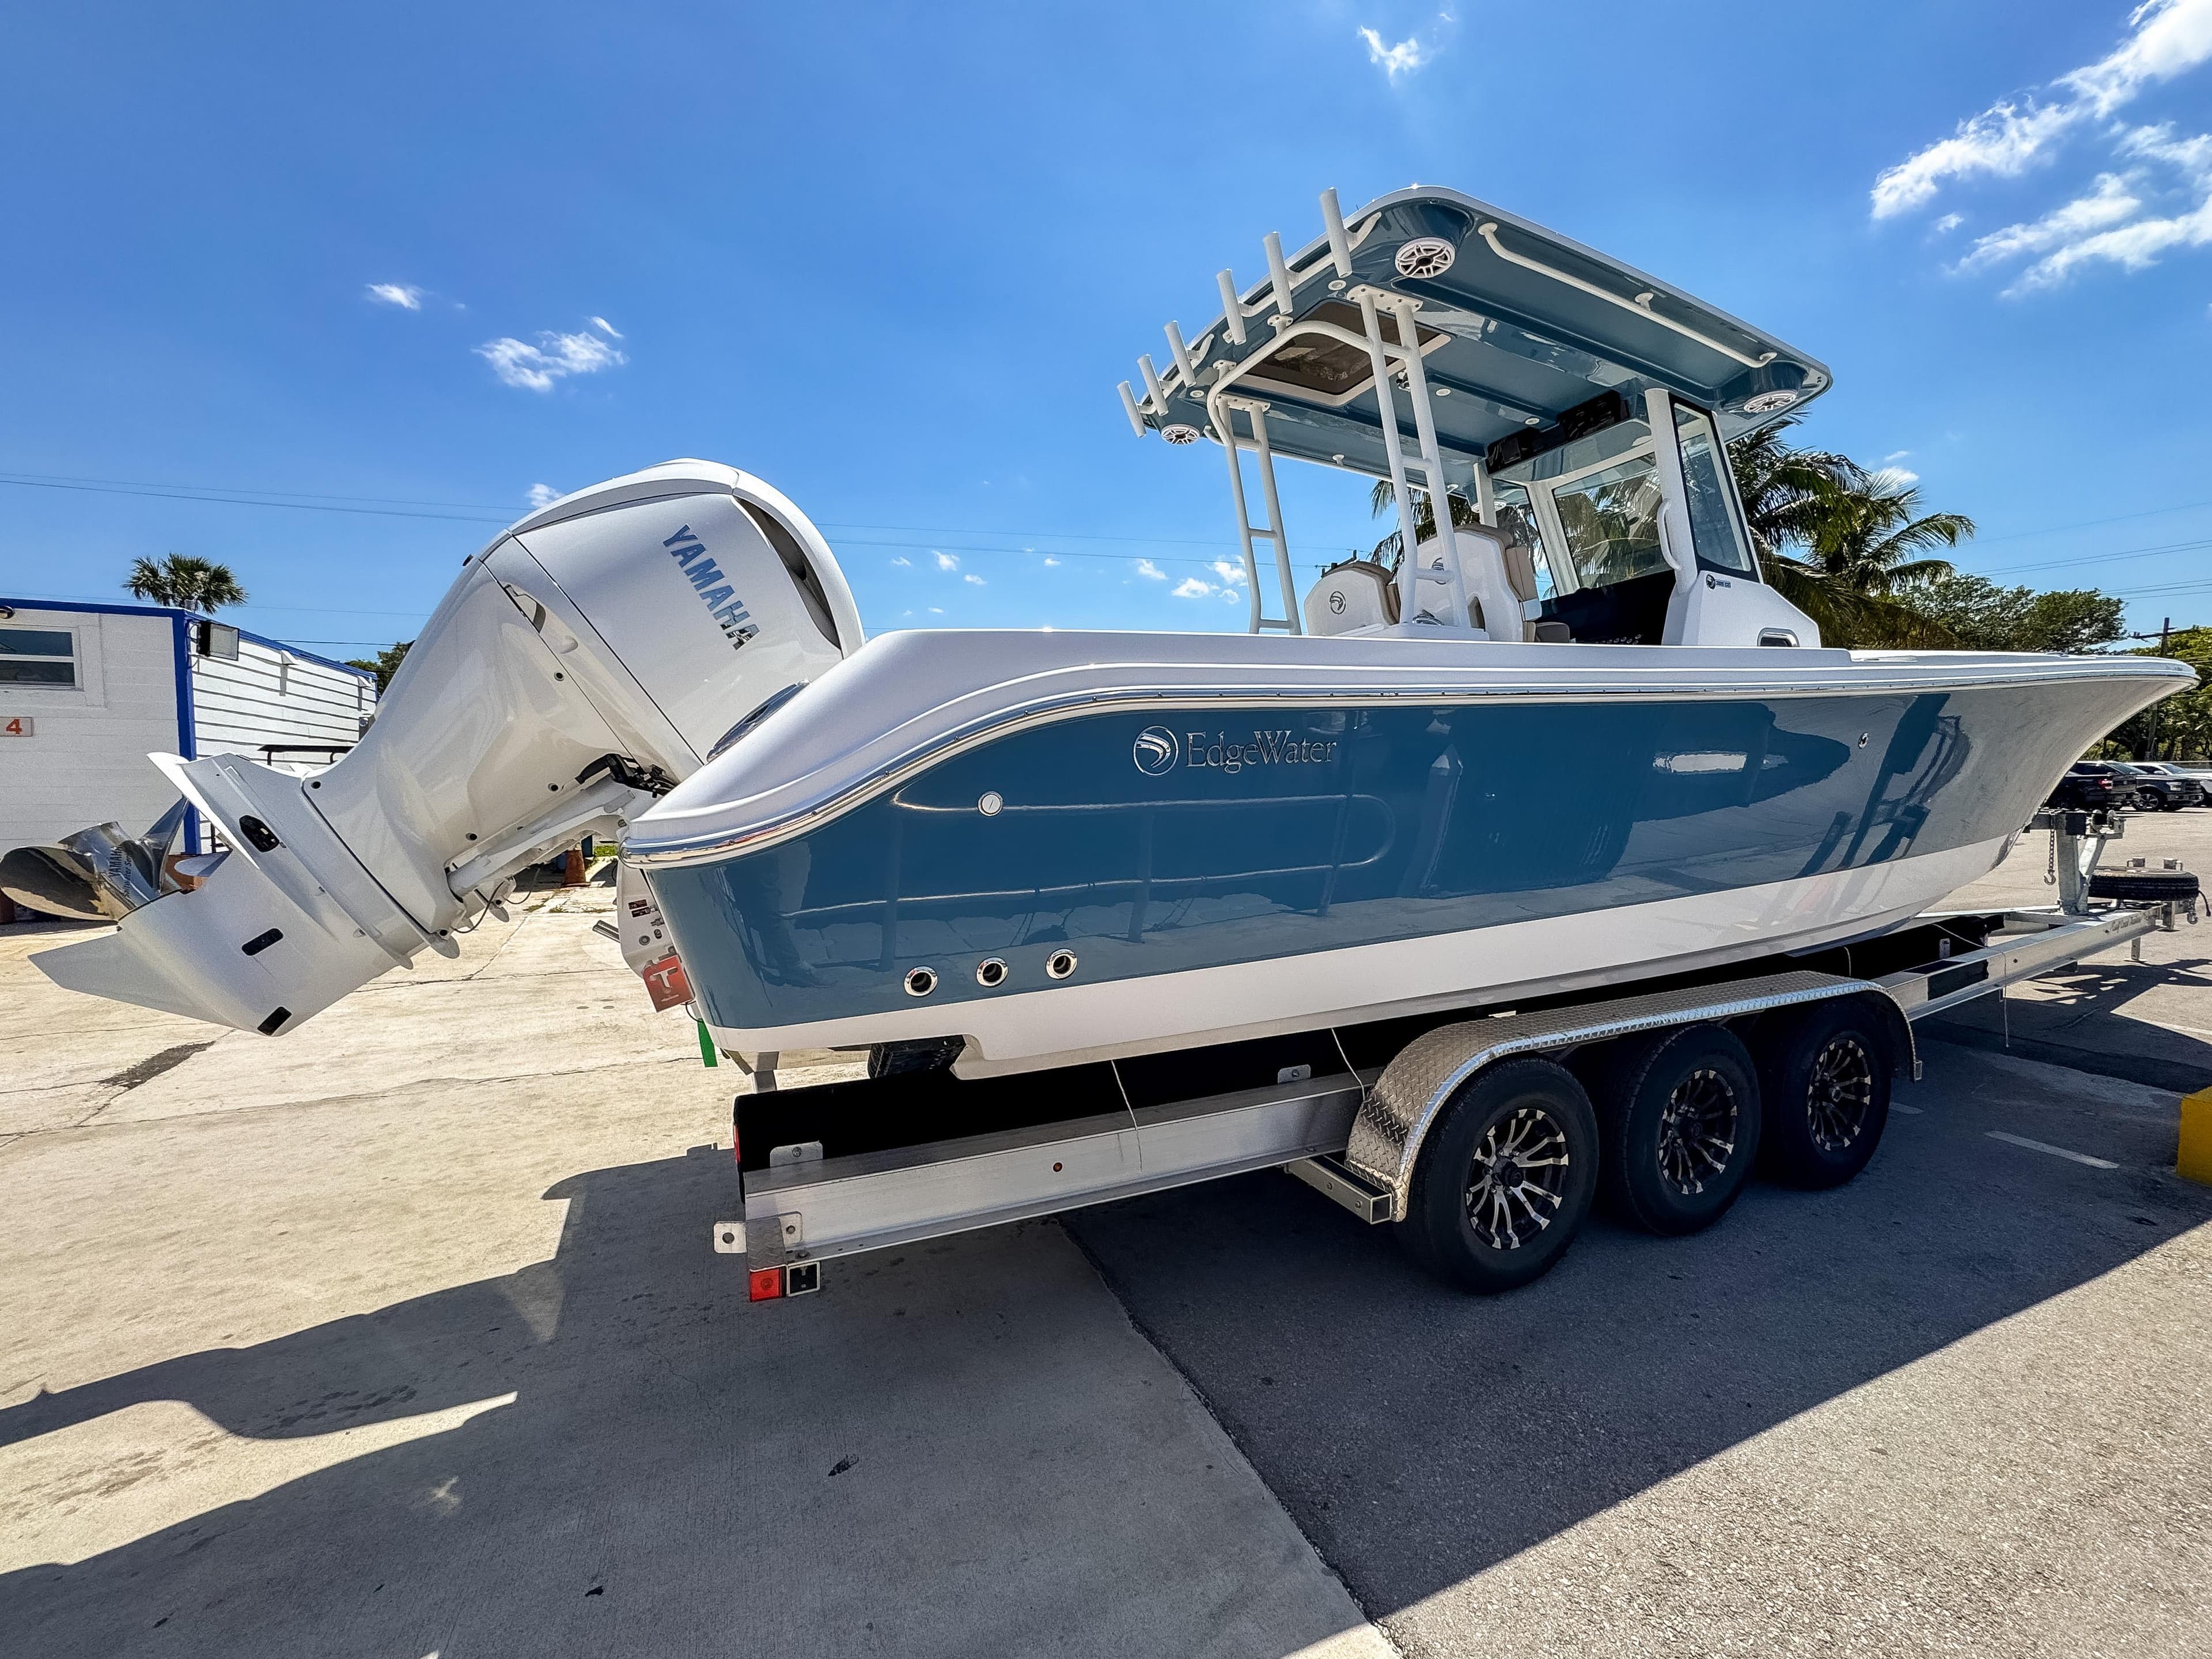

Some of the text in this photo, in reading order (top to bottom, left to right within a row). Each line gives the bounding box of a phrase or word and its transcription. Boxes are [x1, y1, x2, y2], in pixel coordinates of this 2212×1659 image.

[663, 524, 760, 650] YAMAHA
[6, 719, 22, 734] 4
[1185, 730, 1337, 774] EdgeWater
